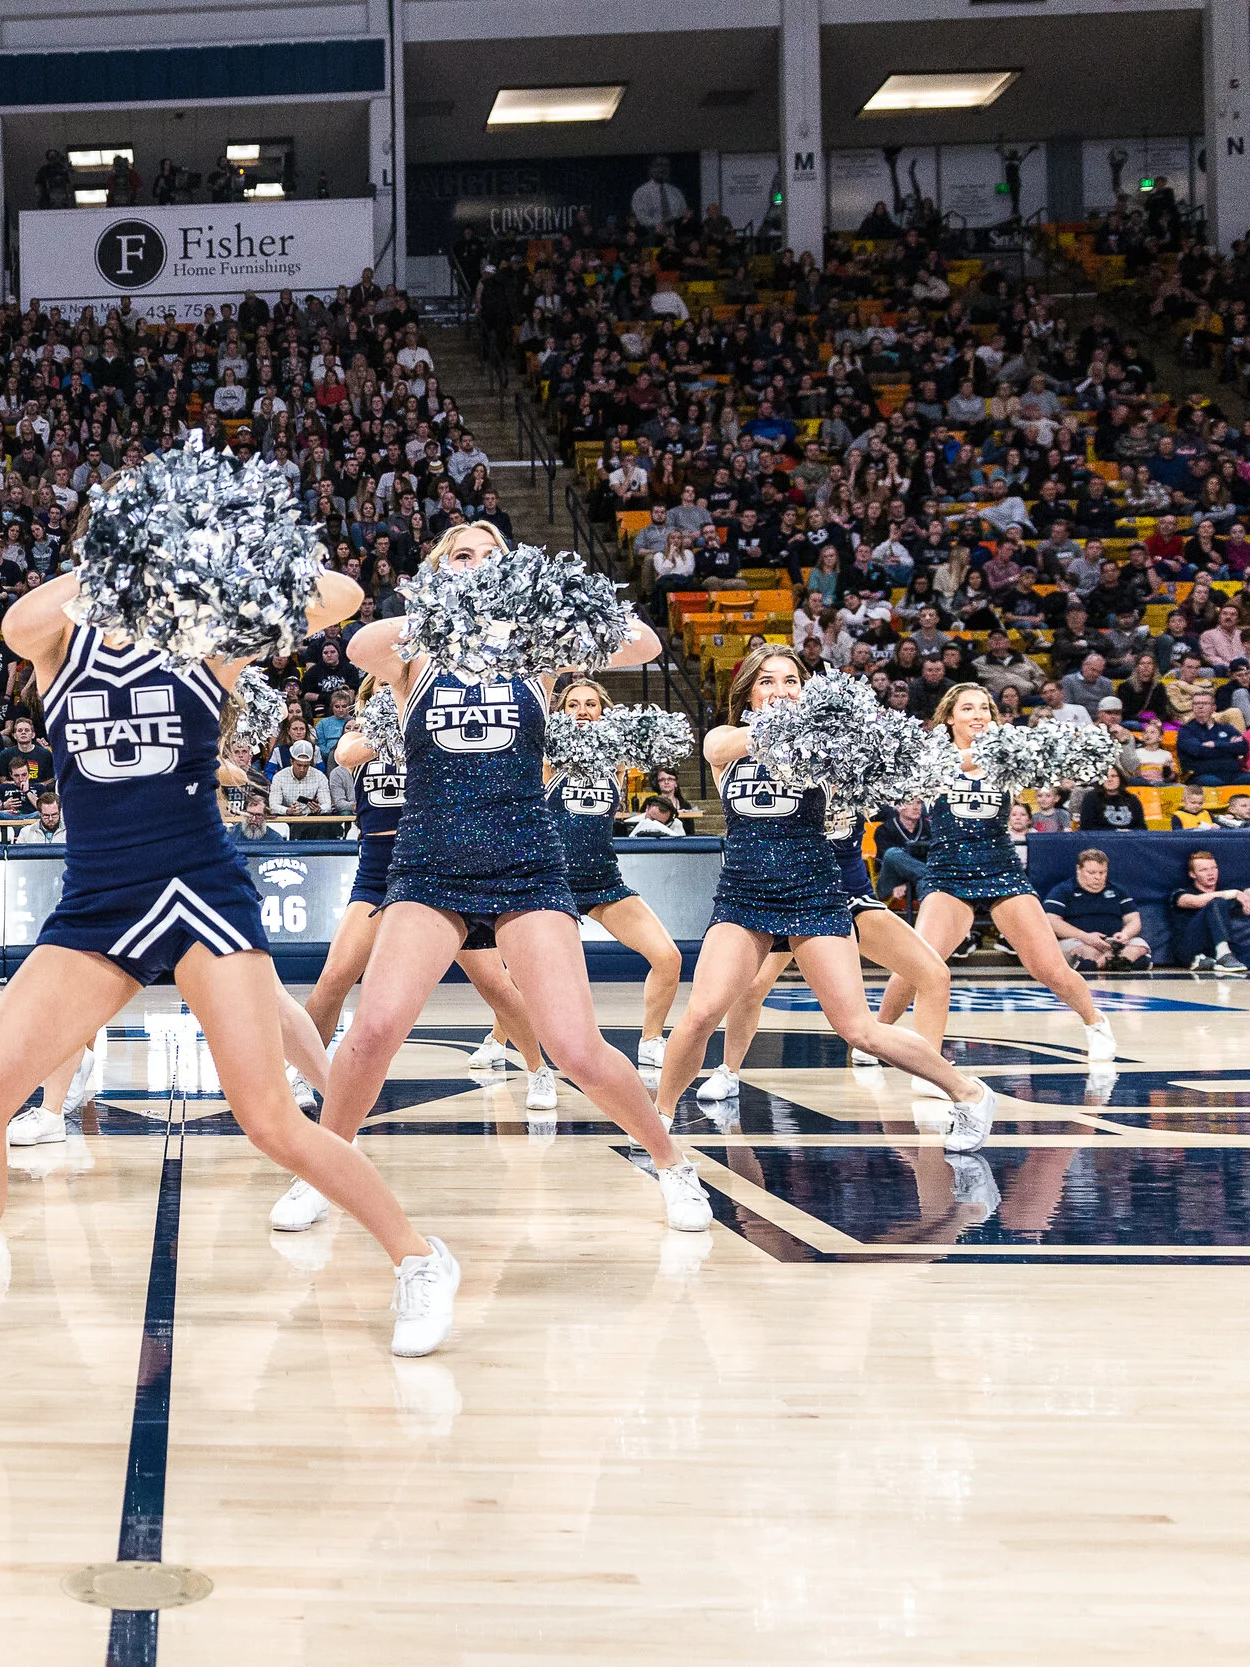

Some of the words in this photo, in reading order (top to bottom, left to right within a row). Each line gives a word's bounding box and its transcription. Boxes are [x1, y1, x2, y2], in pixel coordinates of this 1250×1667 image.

[1227, 137, 1245, 156] N
[795, 152, 814, 171] M
[489, 205, 590, 235] CONSERVIC
[178, 222, 295, 260] Fisher
[115, 234, 146, 275] F
[173, 262, 217, 277] Home
[220, 260, 301, 277] Furnishings
[425, 704, 521, 731] STATE
[65, 715, 185, 753] STATE
[363, 774, 407, 793] STAT
[727, 780, 804, 800] STATE
[561, 785, 614, 803] STATE
[947, 790, 1003, 807] STATE
[258, 858, 309, 875] NEVADA
[260, 895, 307, 933] 46
